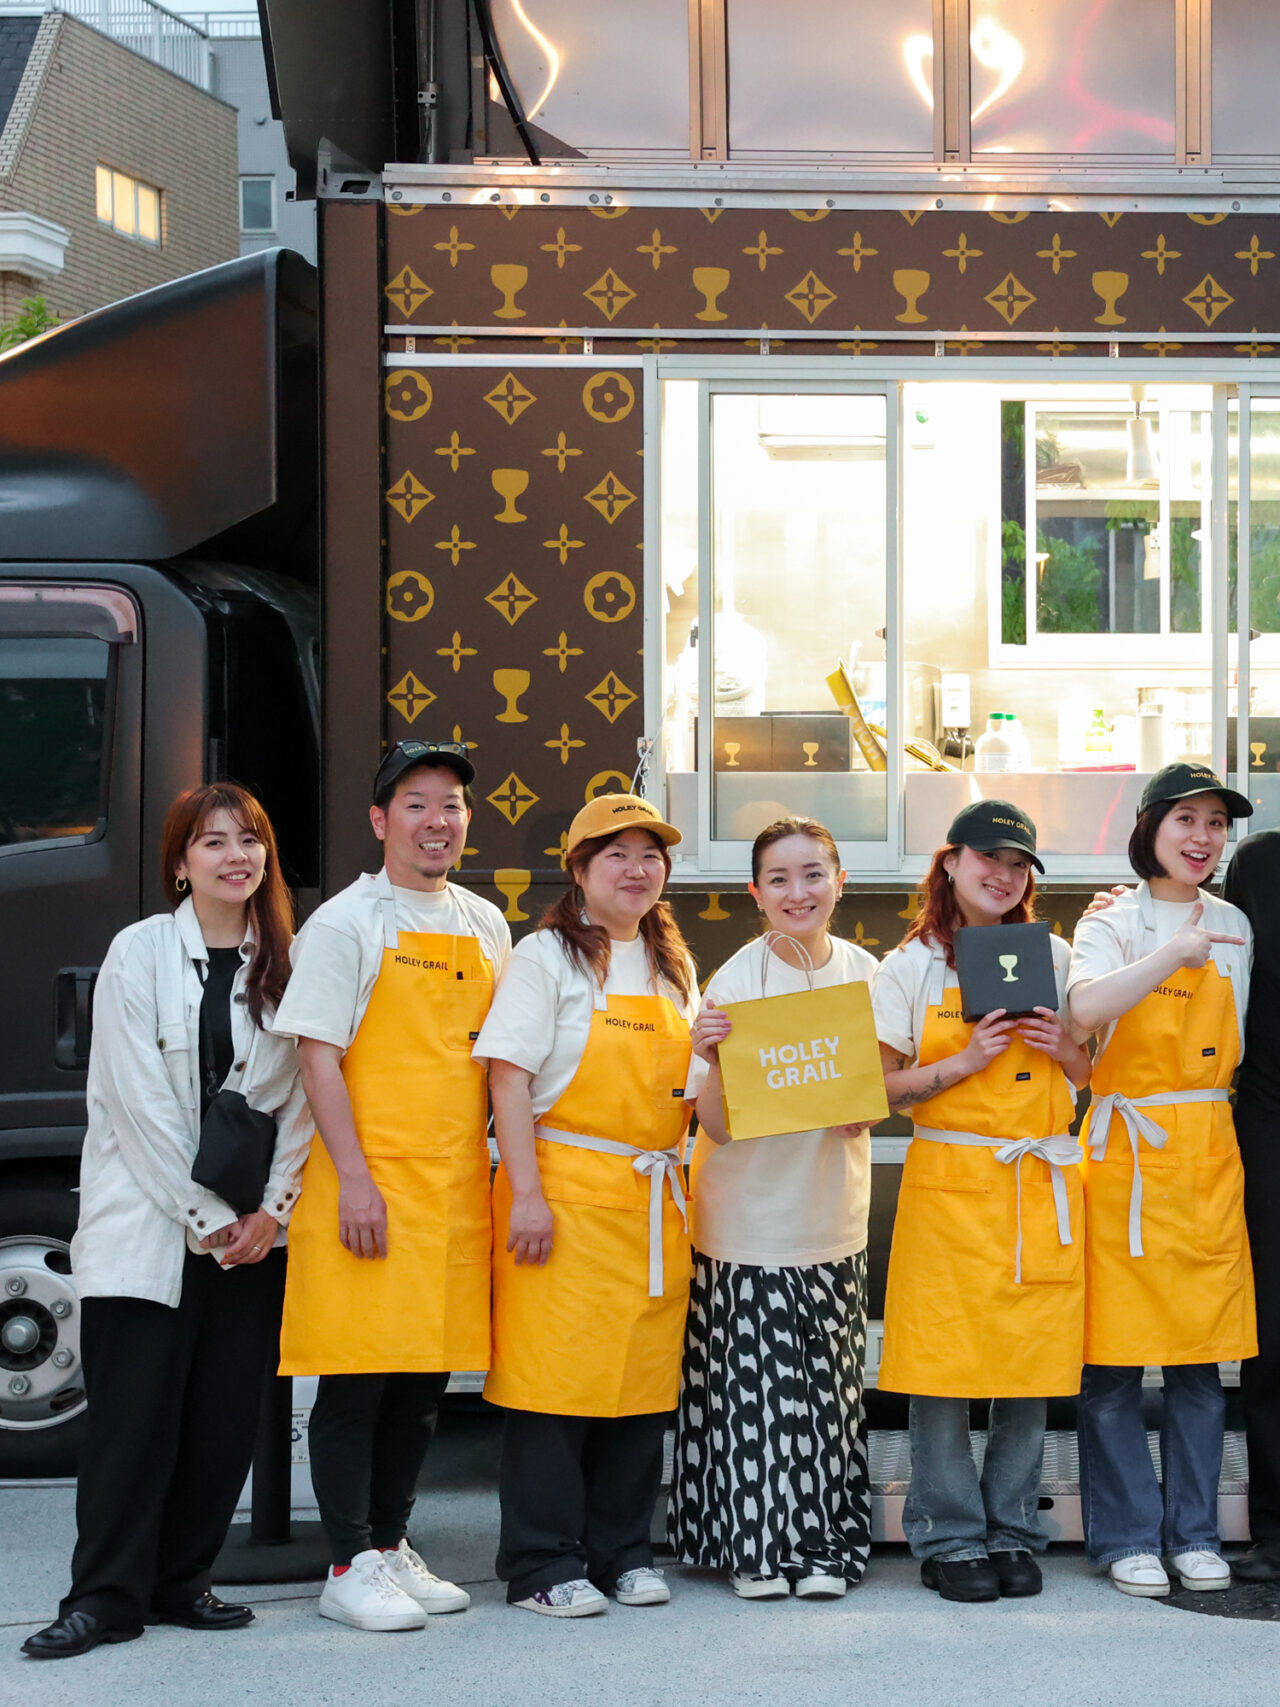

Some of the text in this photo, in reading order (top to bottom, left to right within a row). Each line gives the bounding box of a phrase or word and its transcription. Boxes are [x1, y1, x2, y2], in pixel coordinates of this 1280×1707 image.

[612, 805, 637, 814] HOLEY
[992, 817, 1015, 827] HOLEY
[395, 955, 449, 971] HOLEY GRAIL
[1152, 985, 1173, 997] OLEY
[937, 1010, 963, 1019] HOLE
[605, 1017, 656, 1032] HOLEY GRAIL
[759, 1035, 840, 1067] HOLEY
[766, 1059, 843, 1089] GRAIL
